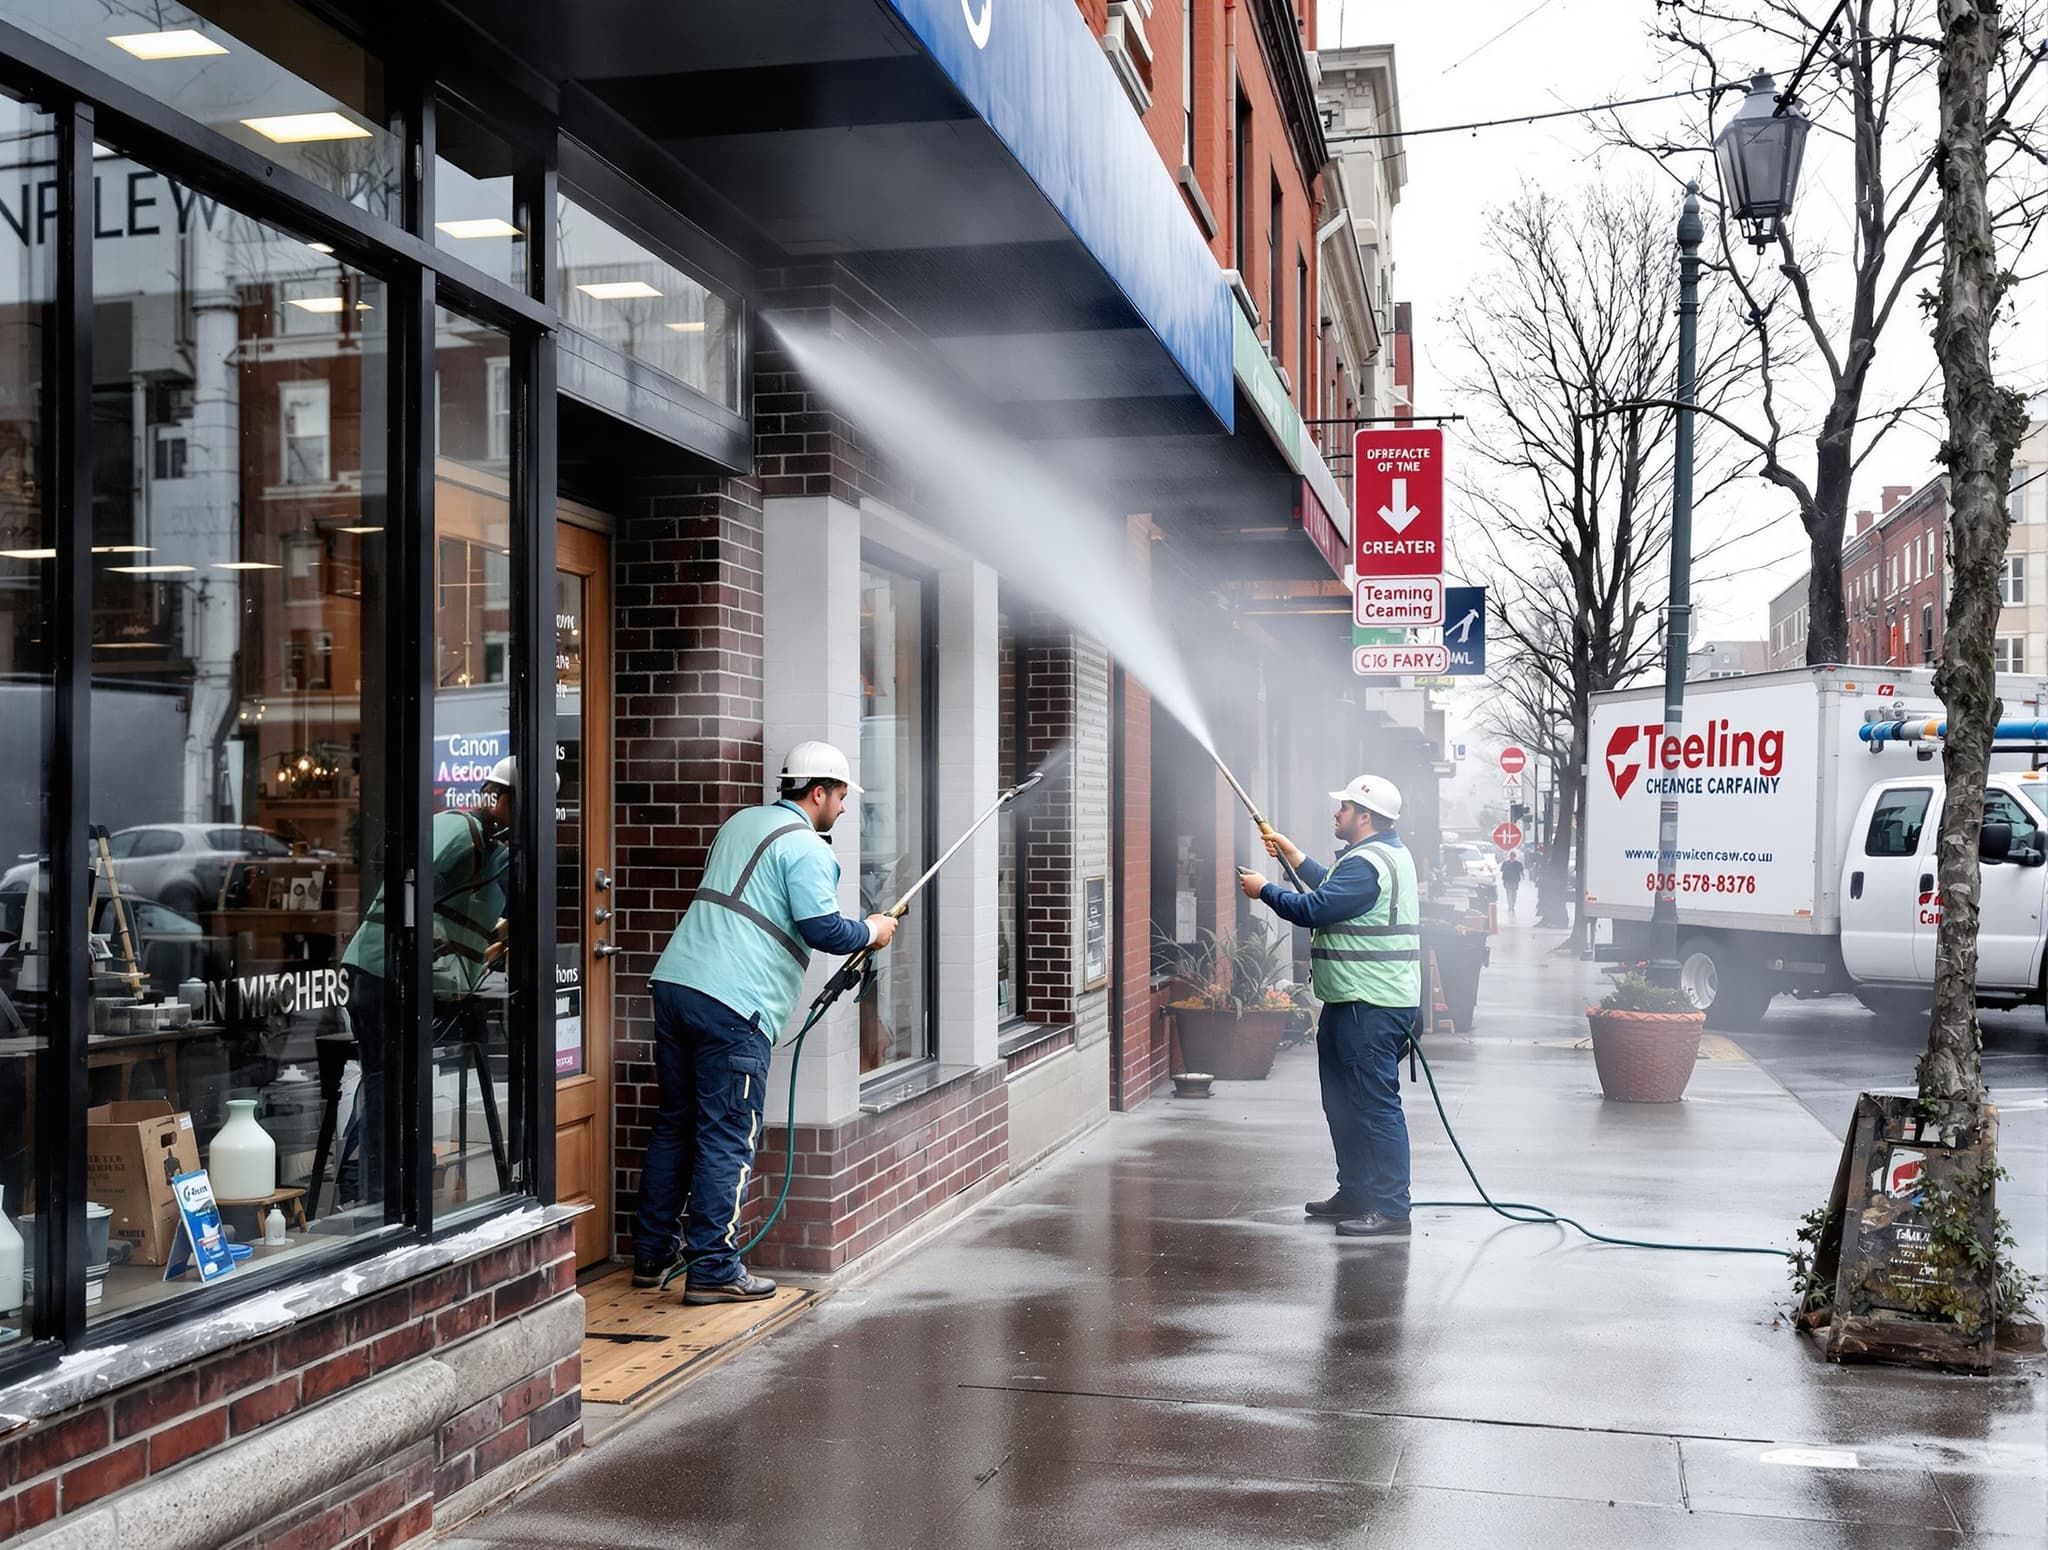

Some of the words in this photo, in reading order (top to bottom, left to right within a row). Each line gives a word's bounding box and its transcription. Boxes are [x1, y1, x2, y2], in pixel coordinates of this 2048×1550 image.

[1377, 462, 1393, 472] OF
[1362, 541, 1435, 554] CREATER
[1364, 586, 1432, 602] Teaming
[1365, 603, 1432, 619] Ceaming
[449, 734, 499, 756] Canon
[1644, 719, 1784, 776] Teeling
[1646, 778, 1703, 794] CHEANGE
[1707, 777, 1780, 794] CARFAINY
